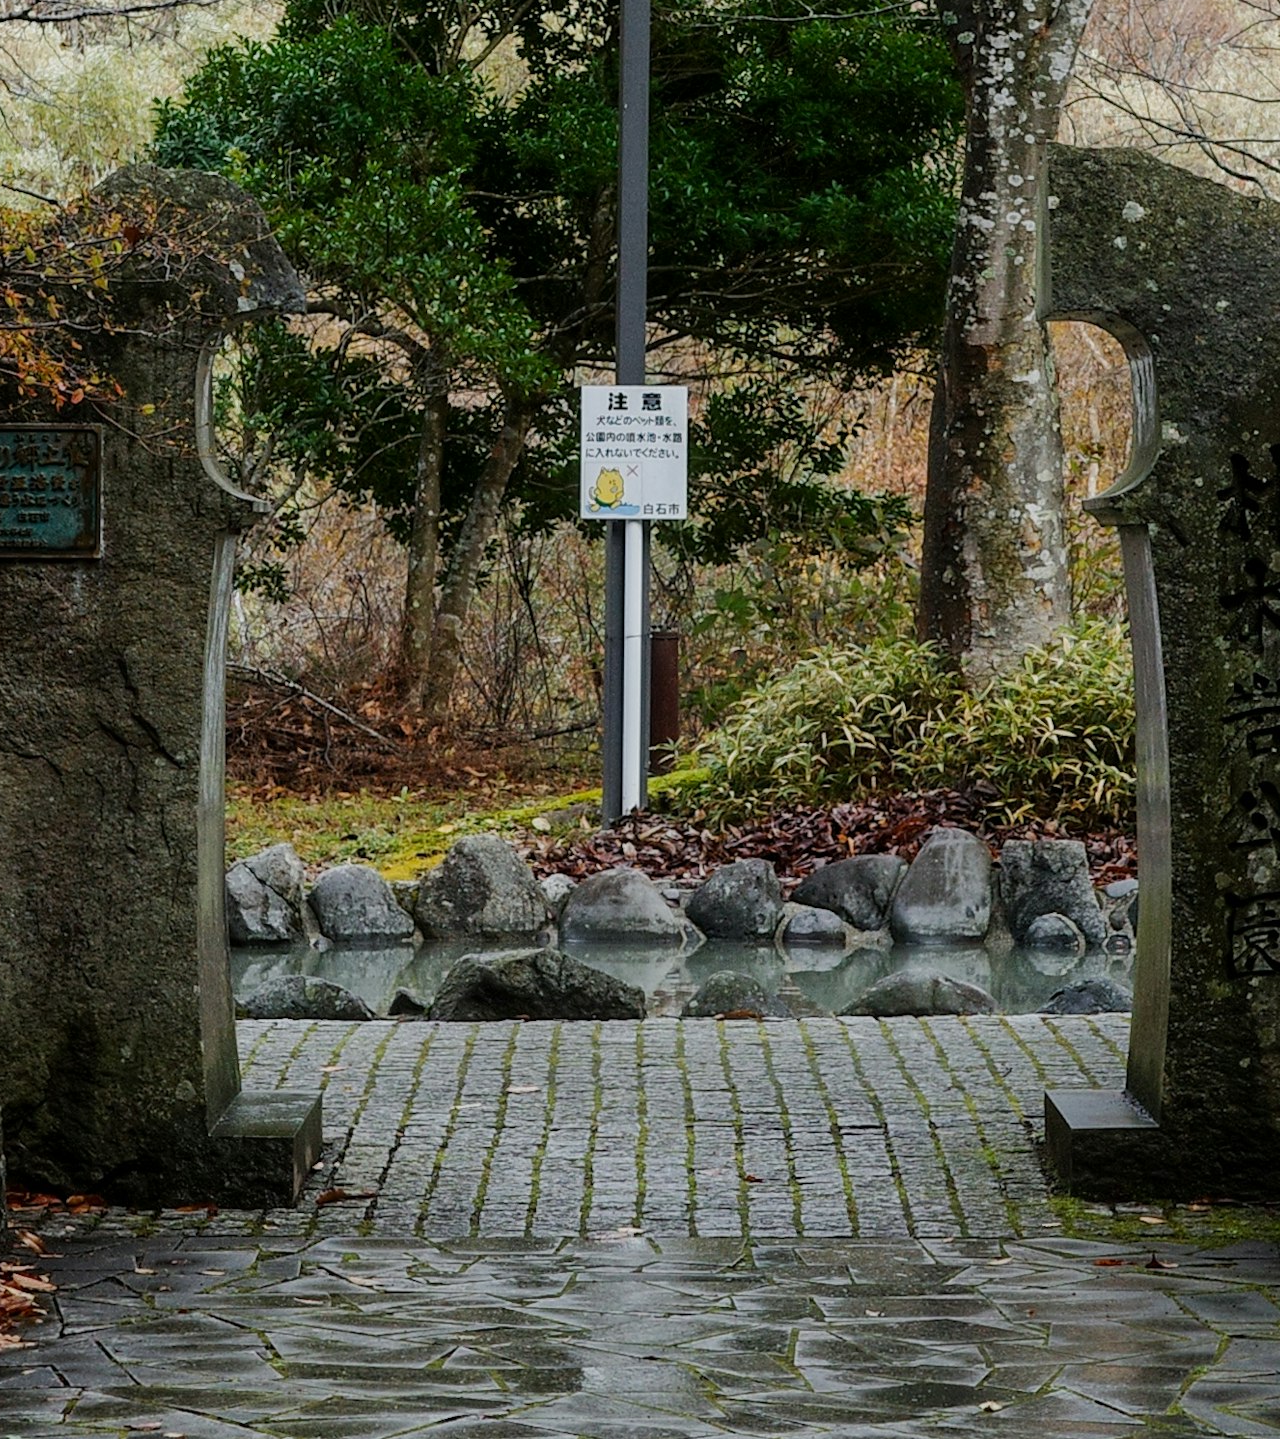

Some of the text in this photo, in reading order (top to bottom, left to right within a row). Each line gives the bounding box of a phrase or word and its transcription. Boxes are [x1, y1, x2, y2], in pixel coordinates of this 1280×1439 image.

[608, 392, 662, 411] 注意
[596, 415, 677, 427] 犬などのペット類を、
[585, 431, 683, 444] 公園内の噴水池・水路
[585, 448, 680, 459] に入れないでください。
[643, 503, 680, 515] 白石市
